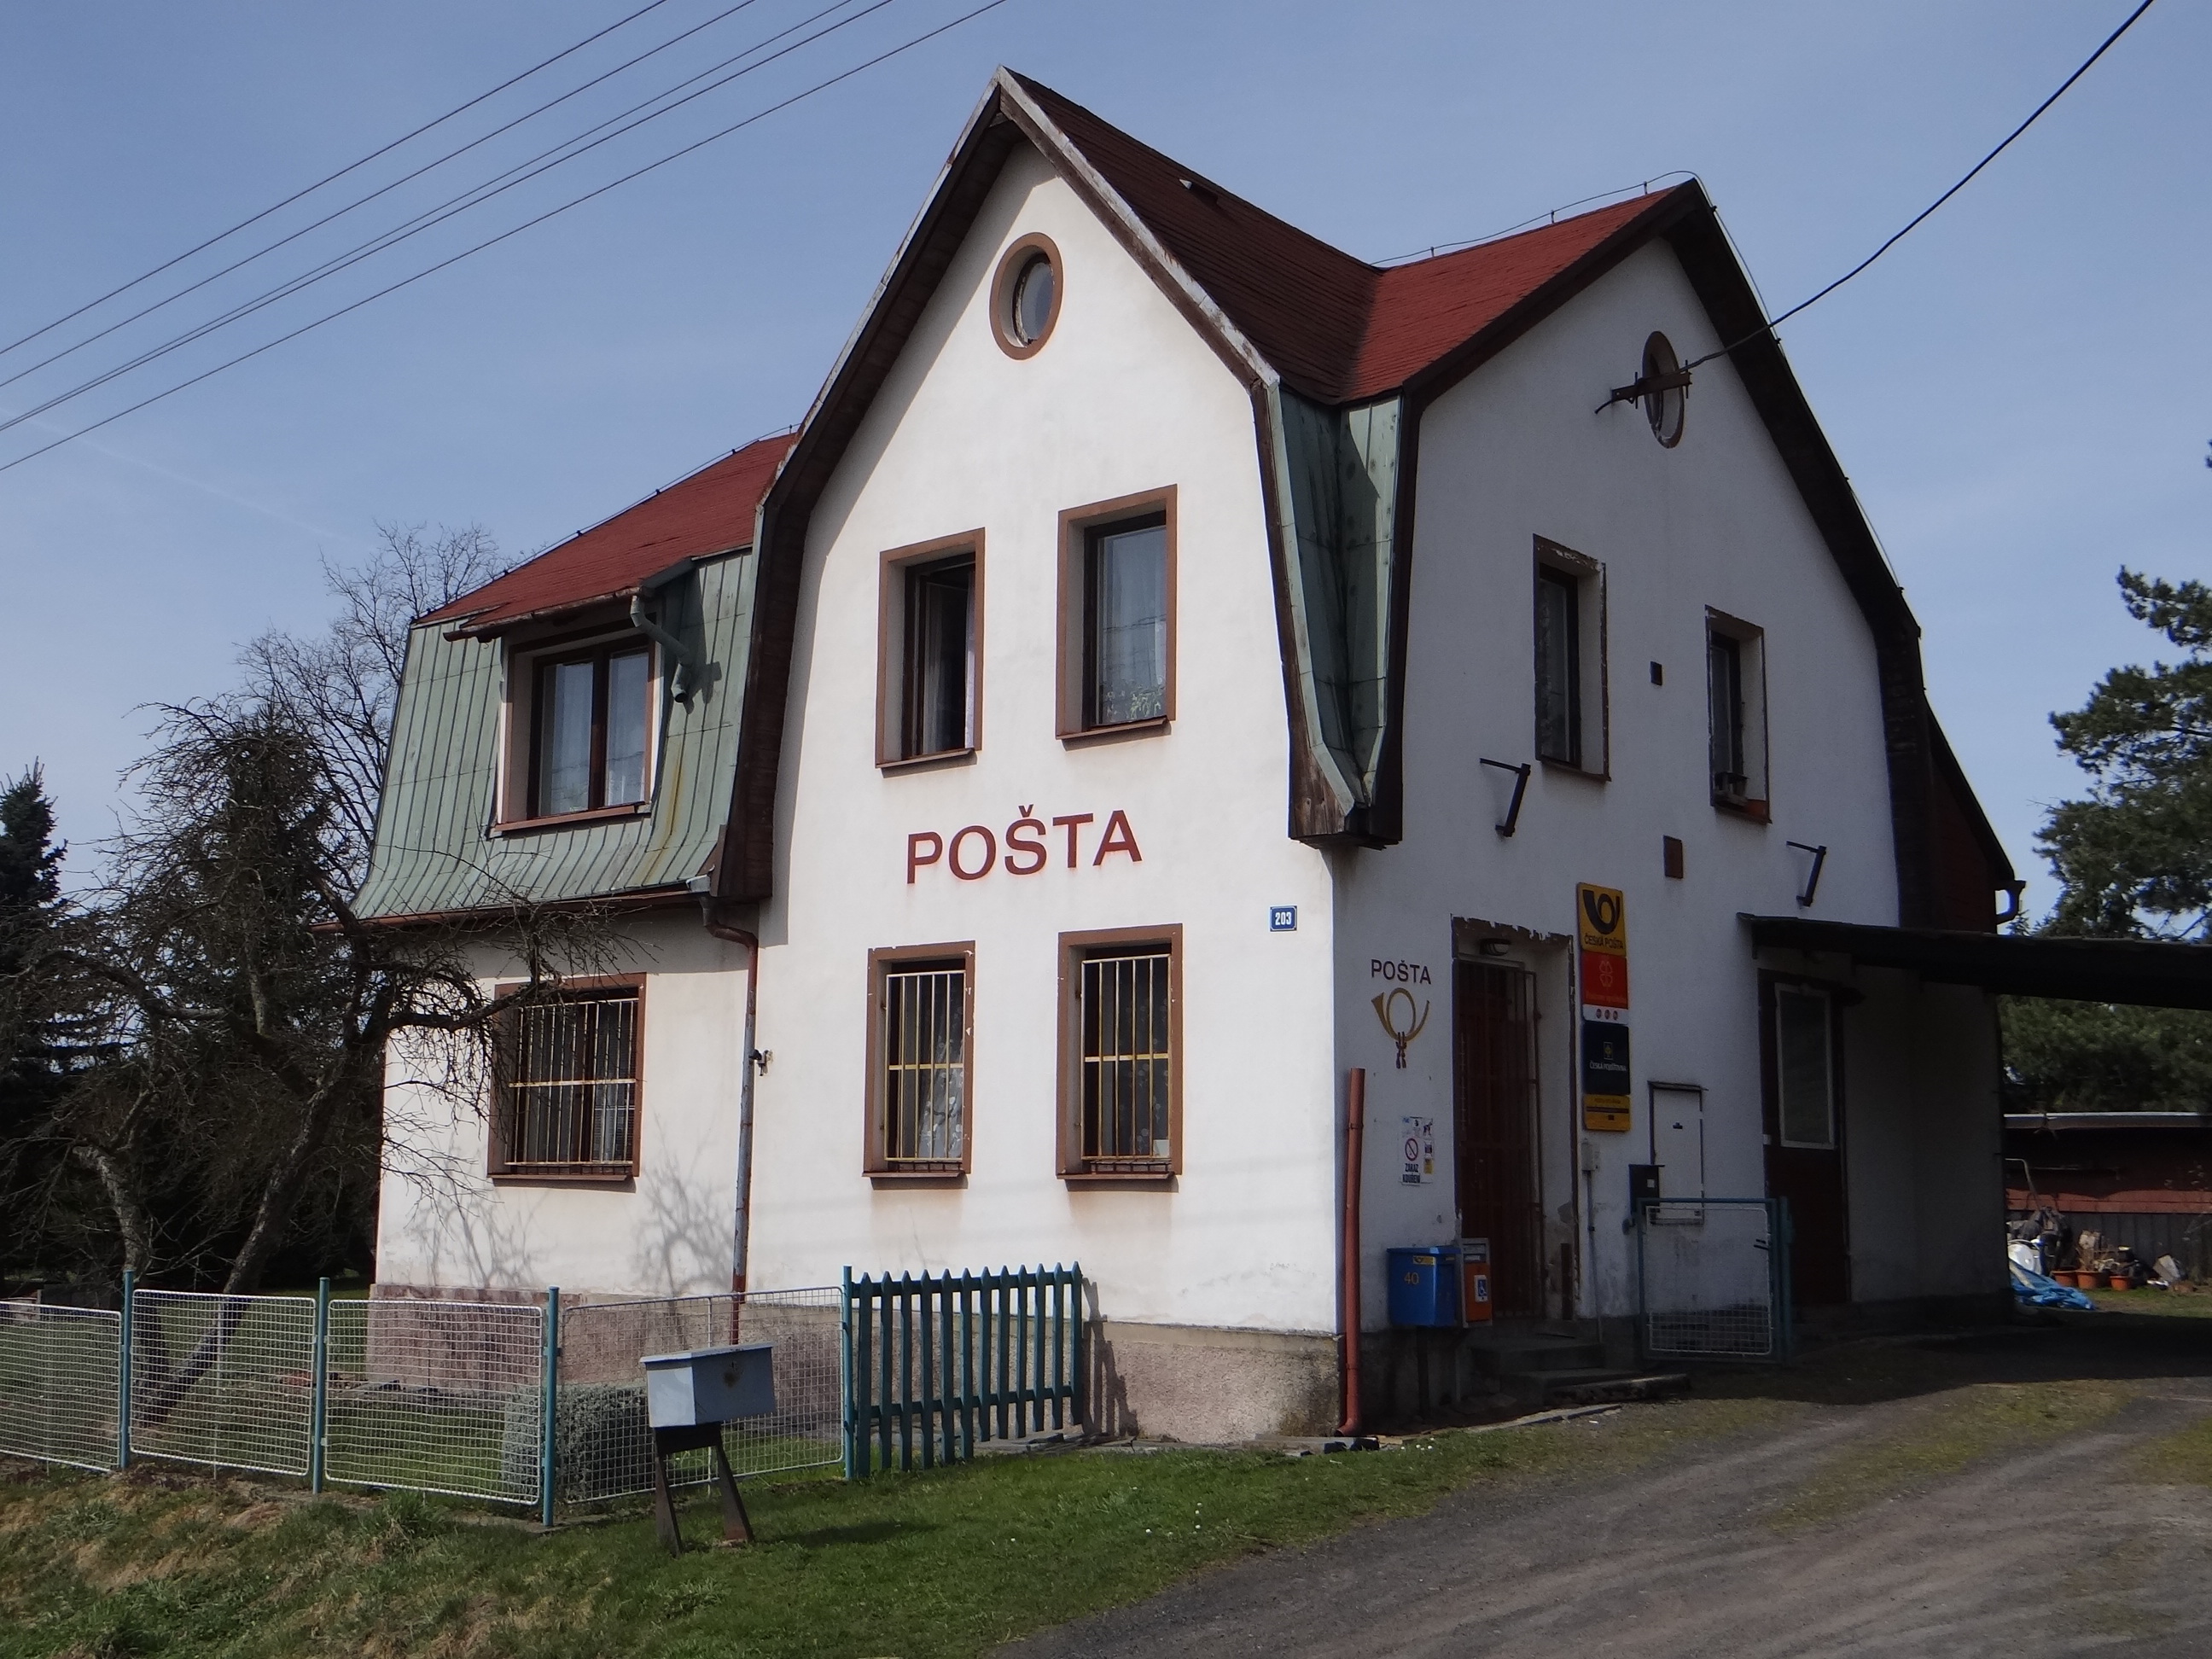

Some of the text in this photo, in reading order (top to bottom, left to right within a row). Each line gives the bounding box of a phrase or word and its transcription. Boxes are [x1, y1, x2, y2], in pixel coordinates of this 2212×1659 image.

[906, 804, 1143, 884] POŠTA
[1275, 911, 1292, 925] 203
[1604, 937, 1624, 949] POŠTA
[1371, 959, 1431, 985] POŠTA
[1404, 1272, 1419, 1284] 40
